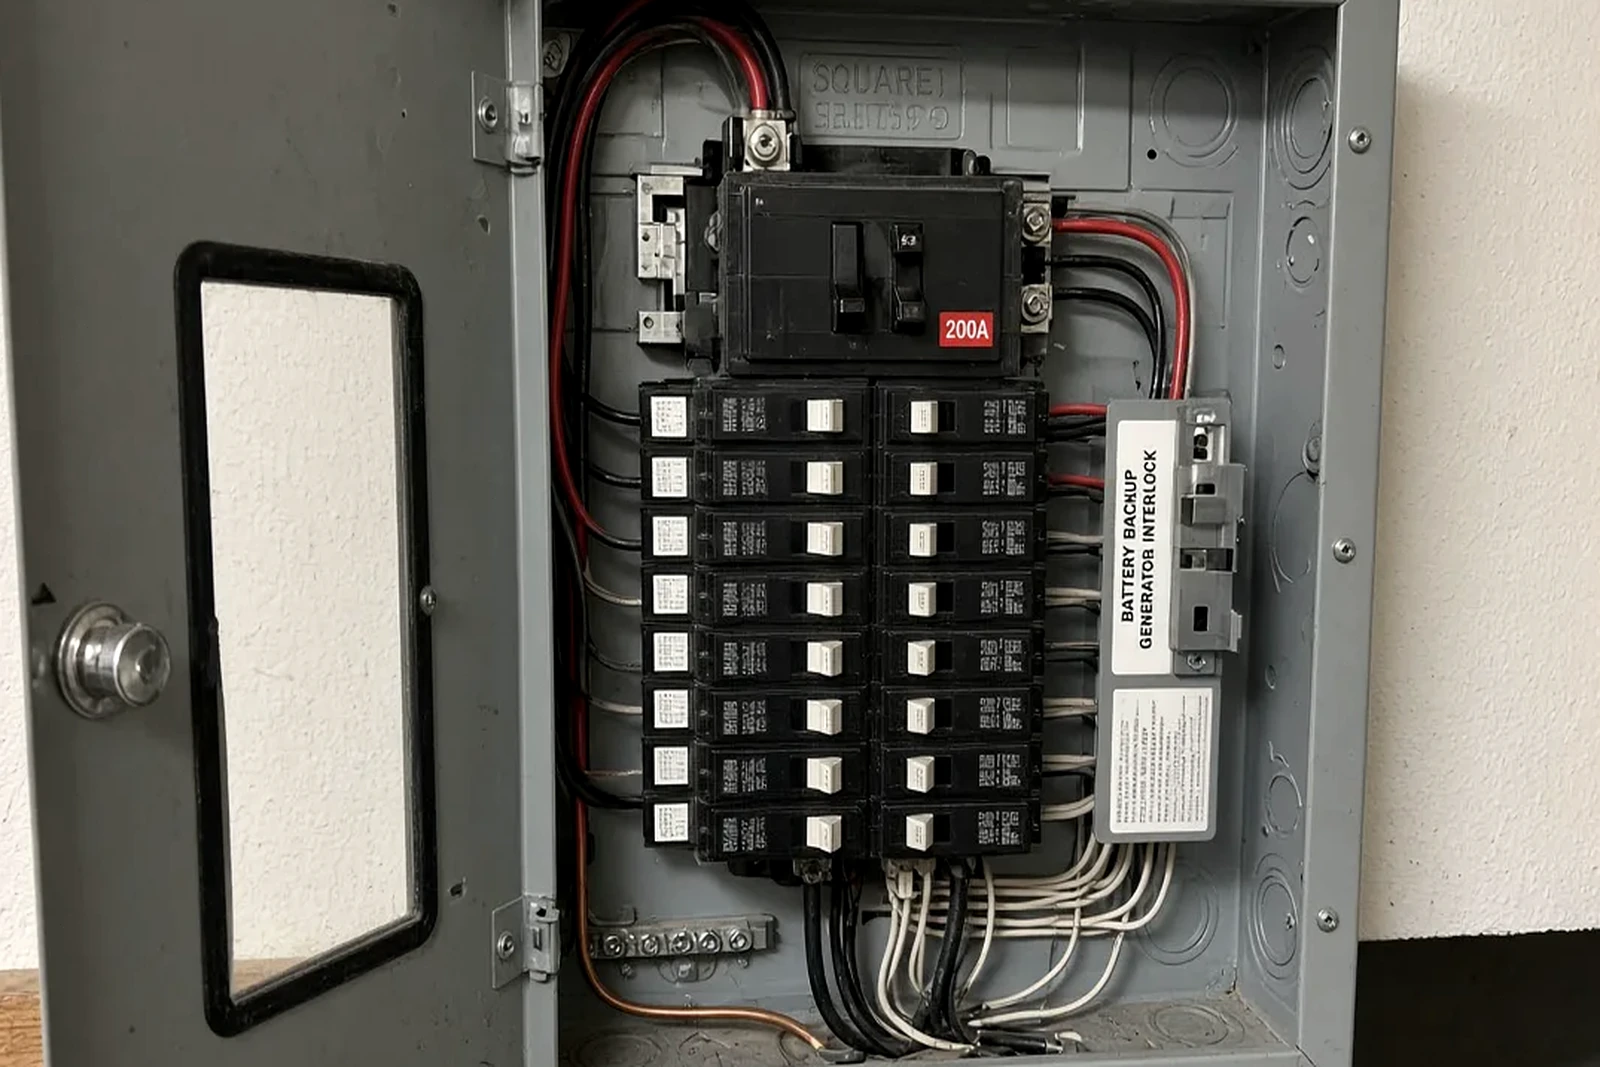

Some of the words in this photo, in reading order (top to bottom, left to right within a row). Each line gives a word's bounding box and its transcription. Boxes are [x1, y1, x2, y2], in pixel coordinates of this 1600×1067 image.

[945, 319, 989, 339] 200A
[1142, 450, 1157, 542] INTERLOCK
[1121, 545, 1135, 622] BATTERY
